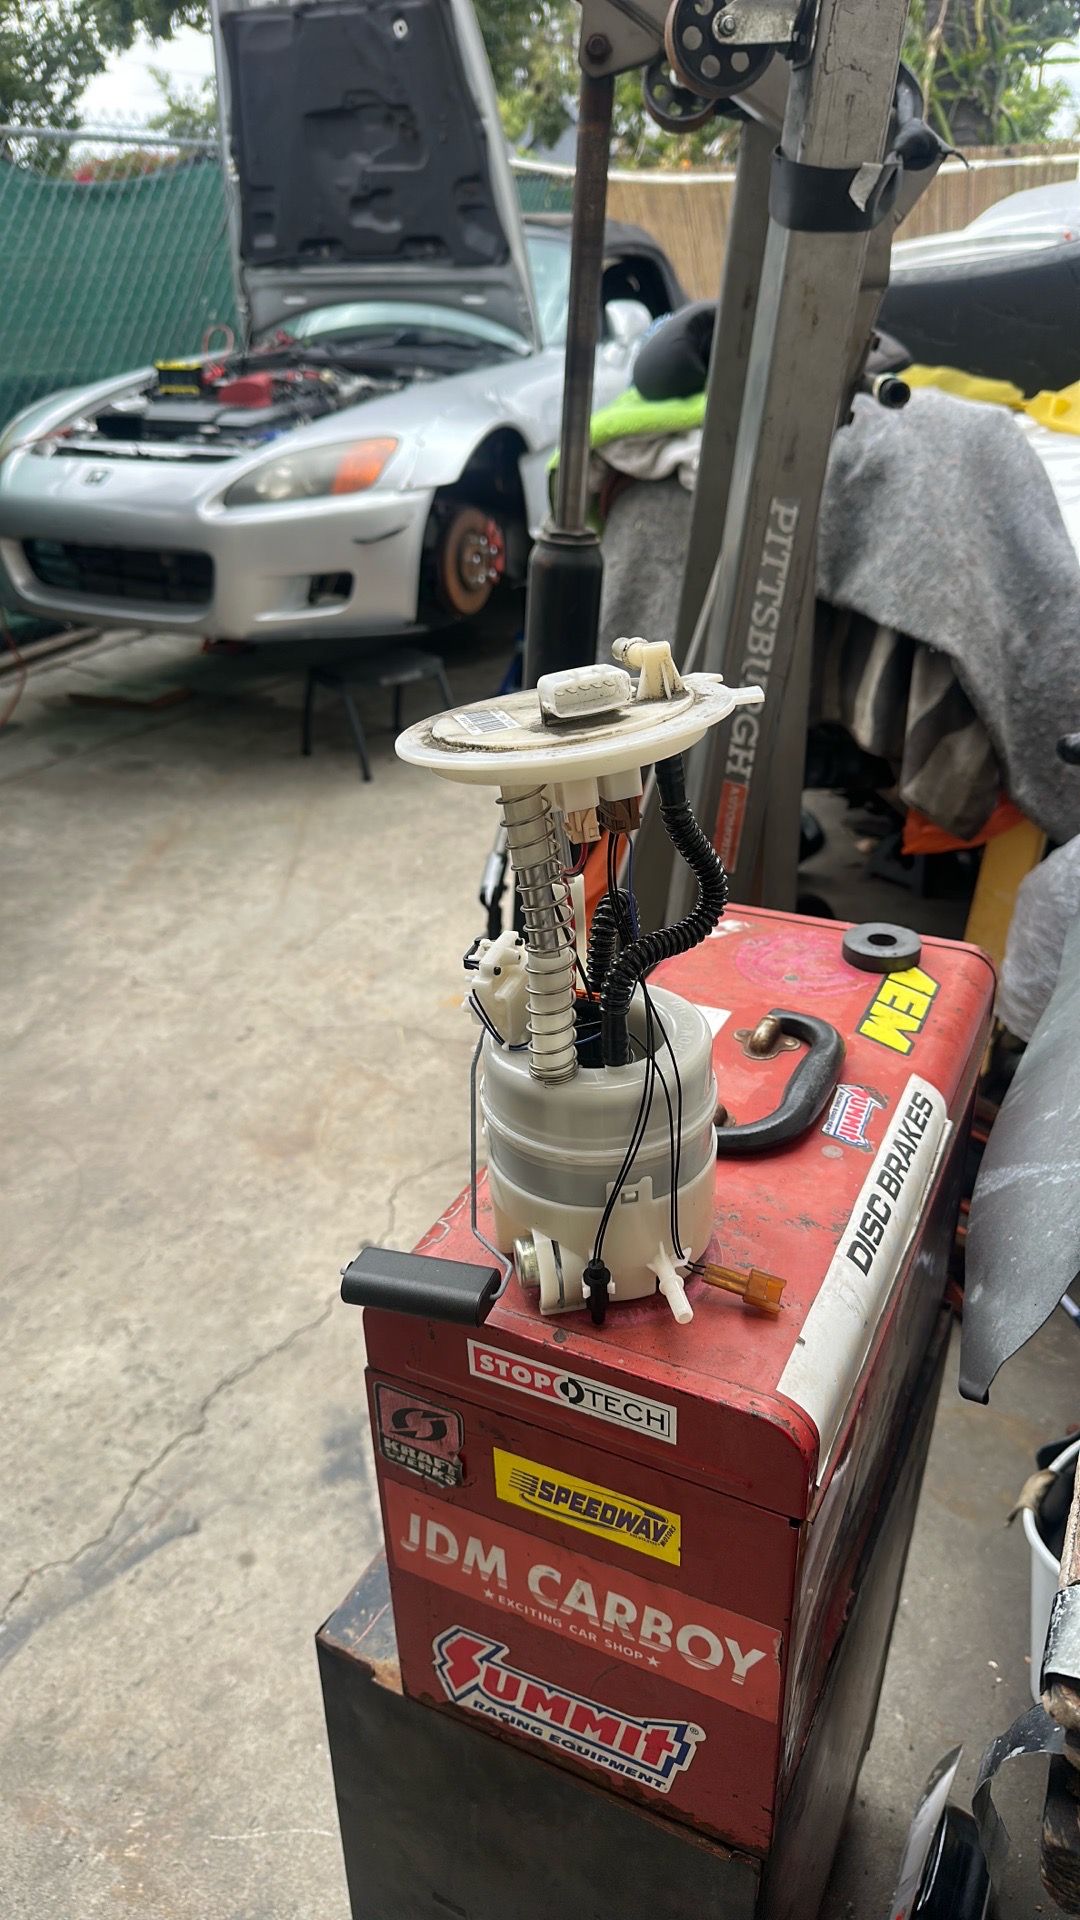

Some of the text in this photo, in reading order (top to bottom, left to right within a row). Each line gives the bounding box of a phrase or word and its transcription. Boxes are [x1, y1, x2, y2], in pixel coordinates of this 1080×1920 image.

[846, 1090, 934, 1277] DISC BRAKES
[537, 1479, 668, 1543] SPEEDWAY
[660, 1524, 677, 1548] MOTORS
[401, 1513, 767, 1686] JDM CARBOY
[498, 1595, 644, 1661] EXCITING CAR SHOP
[472, 1700, 667, 1790] RACING EQUIPMENT
